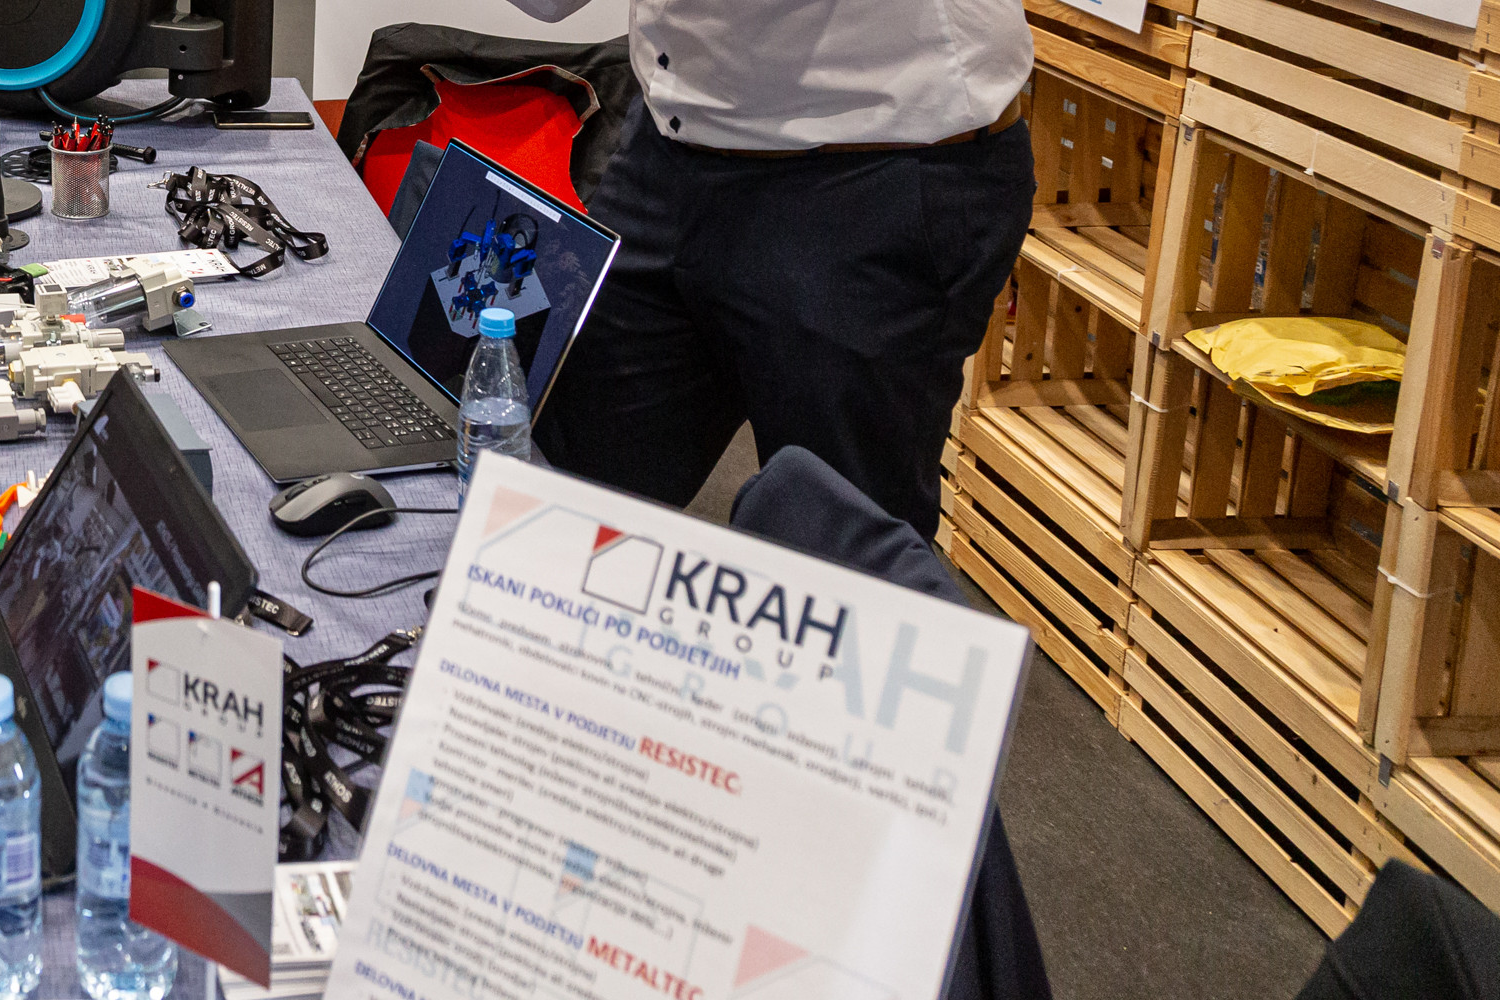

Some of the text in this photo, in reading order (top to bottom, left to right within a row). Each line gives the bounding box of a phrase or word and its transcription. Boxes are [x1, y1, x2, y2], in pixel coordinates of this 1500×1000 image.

[229, 211, 254, 232] RESISTEC
[264, 237, 284, 252] ALTEC
[250, 263, 267, 276] META
[467, 565, 525, 598] ISKANI
[604, 615, 632, 638] PO
[636, 628, 740, 679] PODJETJIH
[665, 551, 848, 658] KRAH
[659, 606, 835, 681] GROUP
[184, 671, 264, 728] KRAH
[440, 659, 502, 693] DELOVNA
[505, 687, 551, 714] MESTA
[553, 707, 563, 719] V
[565, 712, 635, 750] PODJETJU
[386, 841, 450, 881] DELOVNA
[451, 875, 499, 906] MESTA
[501, 900, 511, 913] V
[514, 905, 585, 950] PODJETJU
